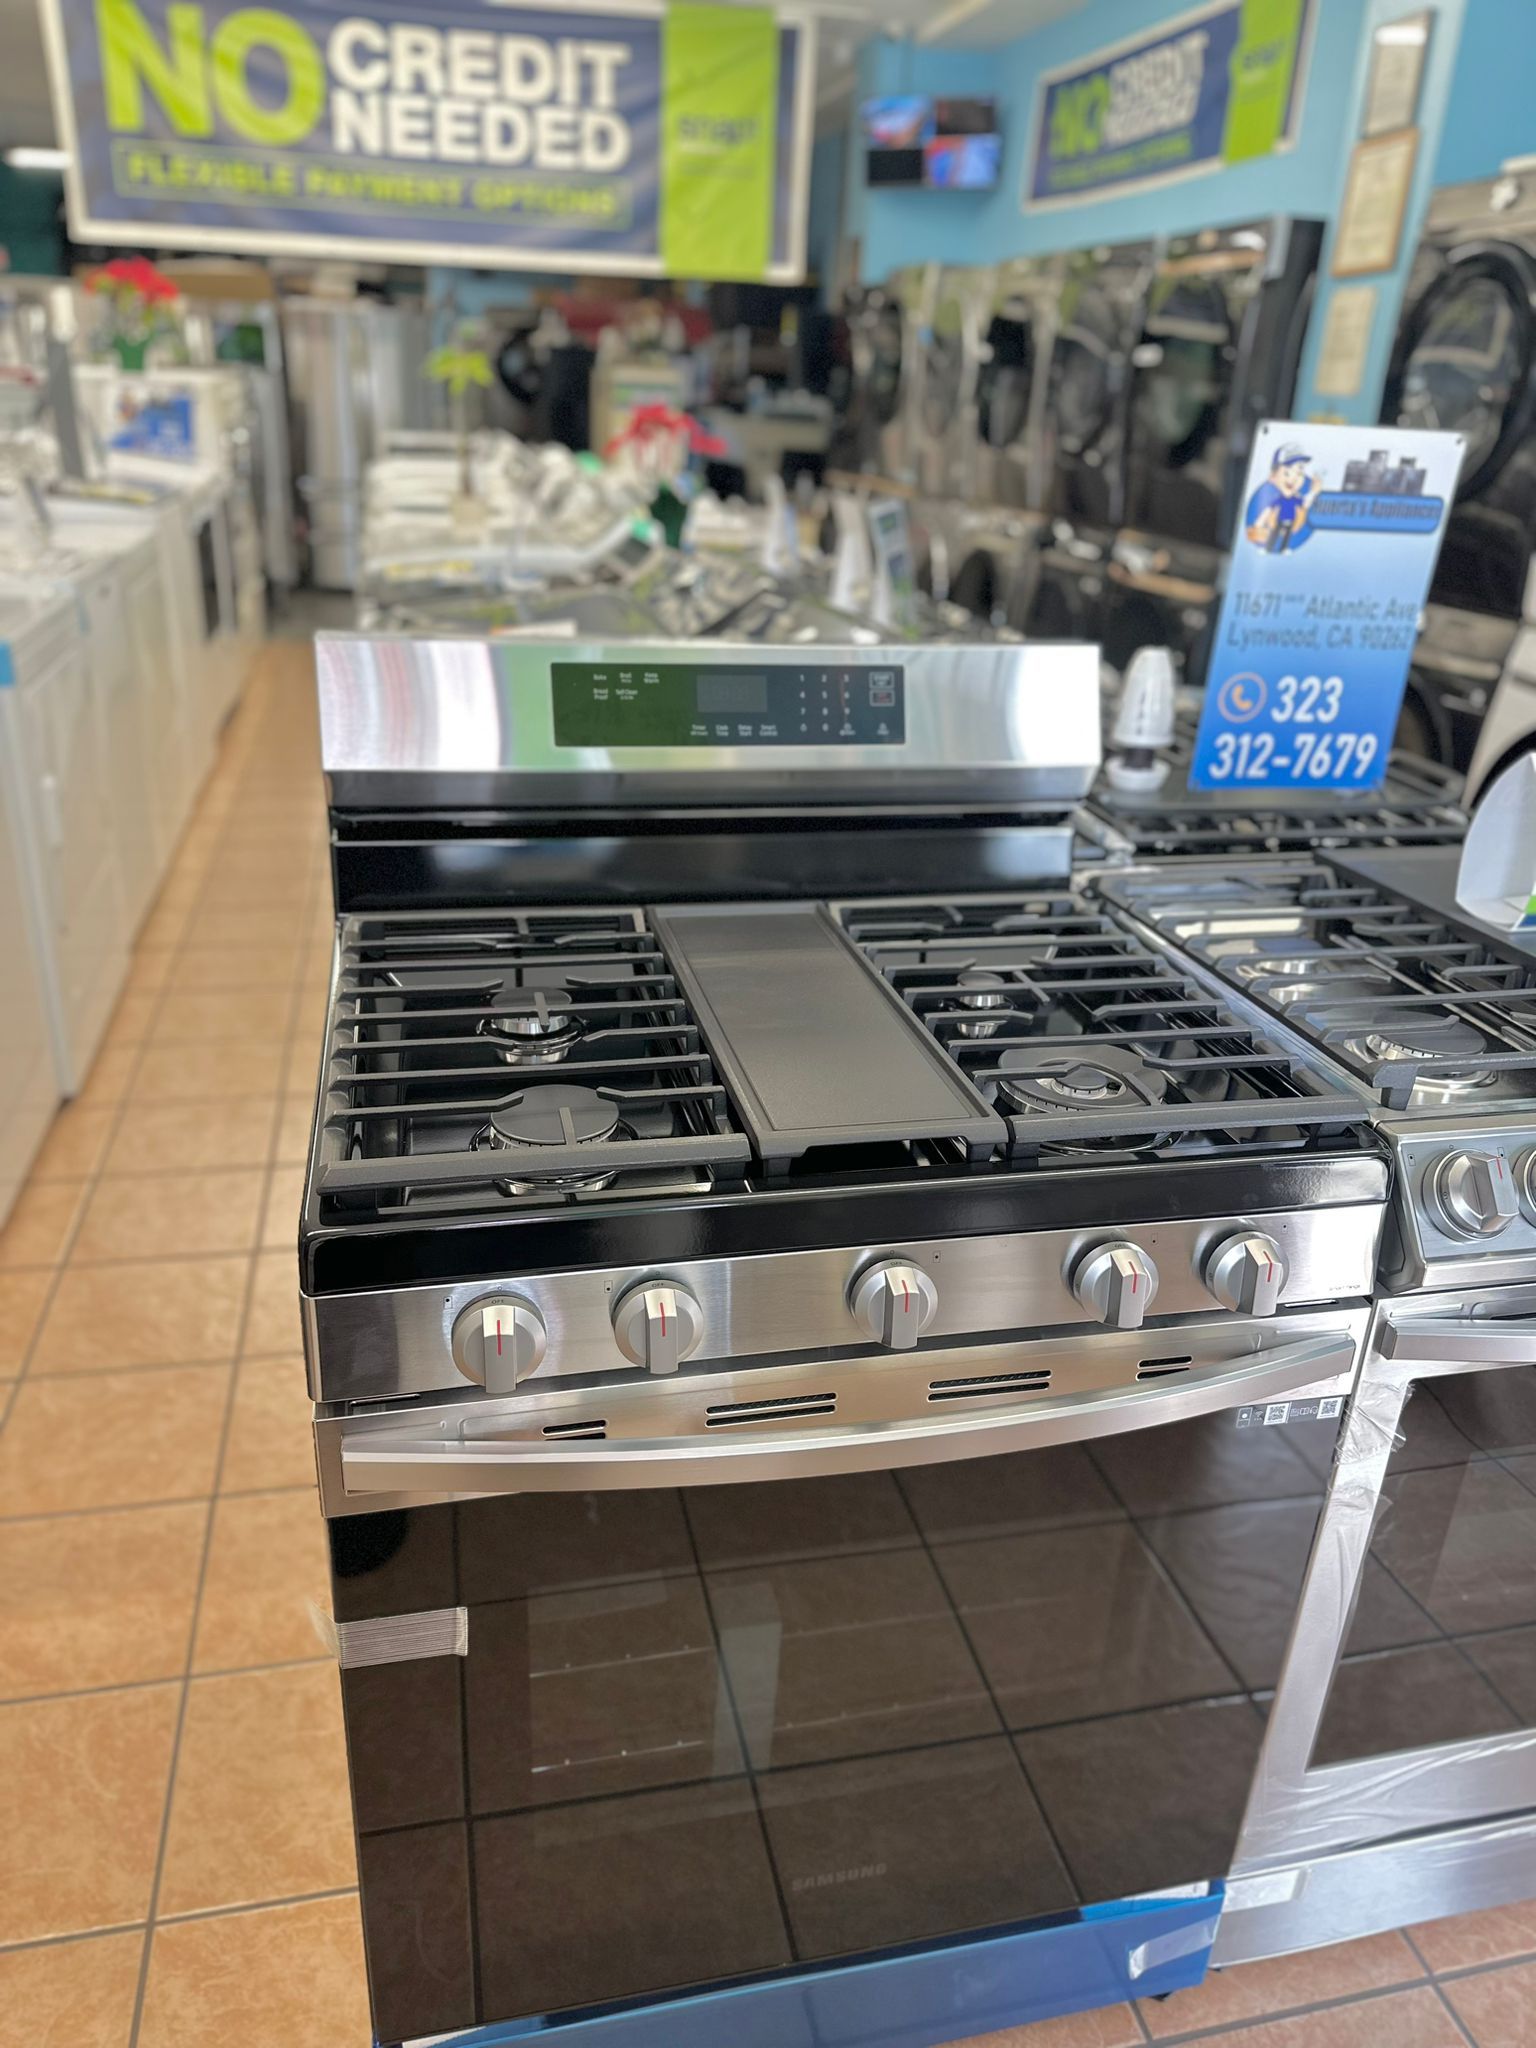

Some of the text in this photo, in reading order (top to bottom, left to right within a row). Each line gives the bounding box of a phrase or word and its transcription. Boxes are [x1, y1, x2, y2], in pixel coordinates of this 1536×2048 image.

[95, 0, 325, 146] NO
[327, 17, 632, 108] CREDIT
[330, 88, 632, 172] NEEDED
[127, 150, 618, 222] FLEXIBLE PAYMENT OPTIONS
[1233, 591, 1282, 617] 11671
[1304, 594, 1380, 620] Atlantic
[1227, 621, 1320, 652] Lynwood,
[1326, 624, 1352, 650] CA
[1271, 674, 1344, 723] 323
[1208, 731, 1378, 779] 312-7679
[792, 1863, 887, 1892] SAMSUNG
